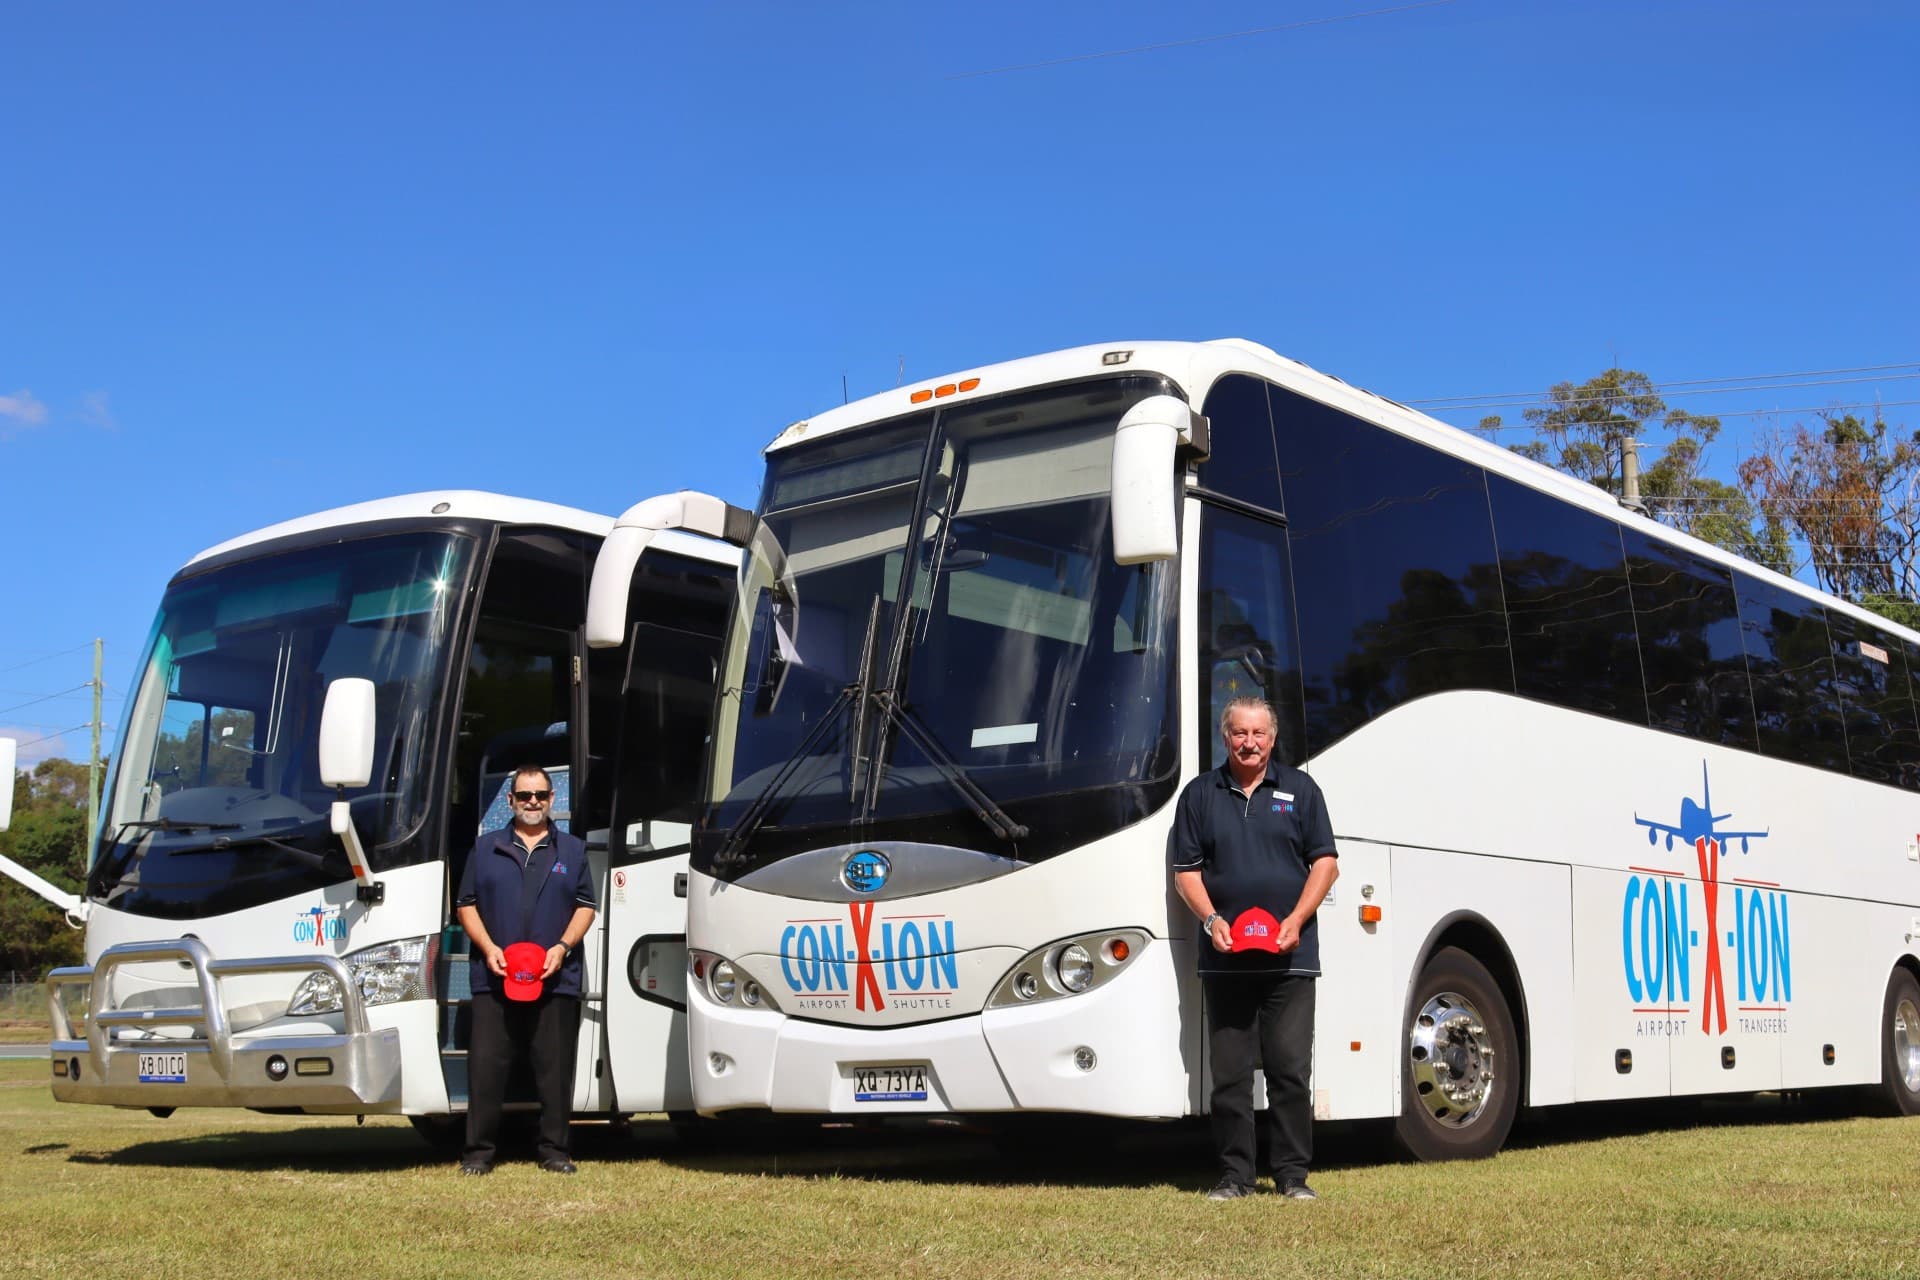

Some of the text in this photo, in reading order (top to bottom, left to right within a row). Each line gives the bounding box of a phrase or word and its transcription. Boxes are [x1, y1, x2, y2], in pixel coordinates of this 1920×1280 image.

[799, 999, 952, 1009] AIRPORT SHUTTLE
[1636, 1018, 1788, 1037] AIRPORT TRANSFERS
